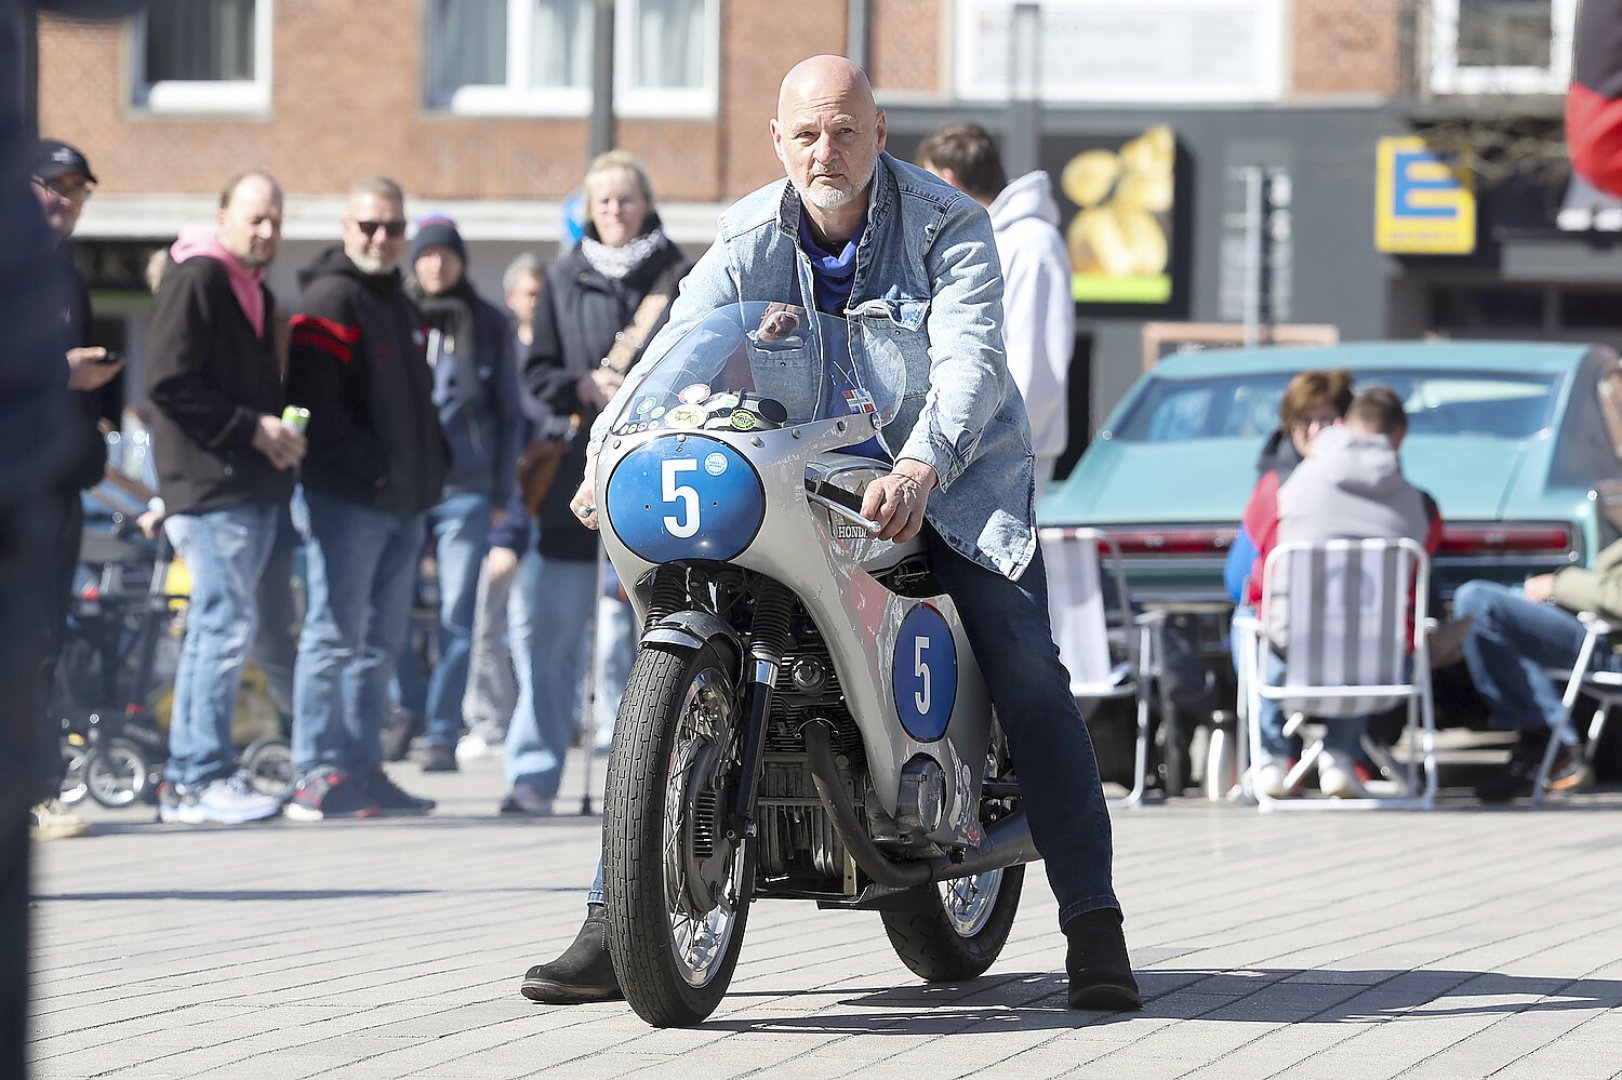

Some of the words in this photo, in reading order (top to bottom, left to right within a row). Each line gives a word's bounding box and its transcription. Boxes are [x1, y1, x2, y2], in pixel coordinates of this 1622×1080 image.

[1394, 153, 1461, 216] E
[661, 458, 700, 538] 5
[914, 636, 931, 715] 5
